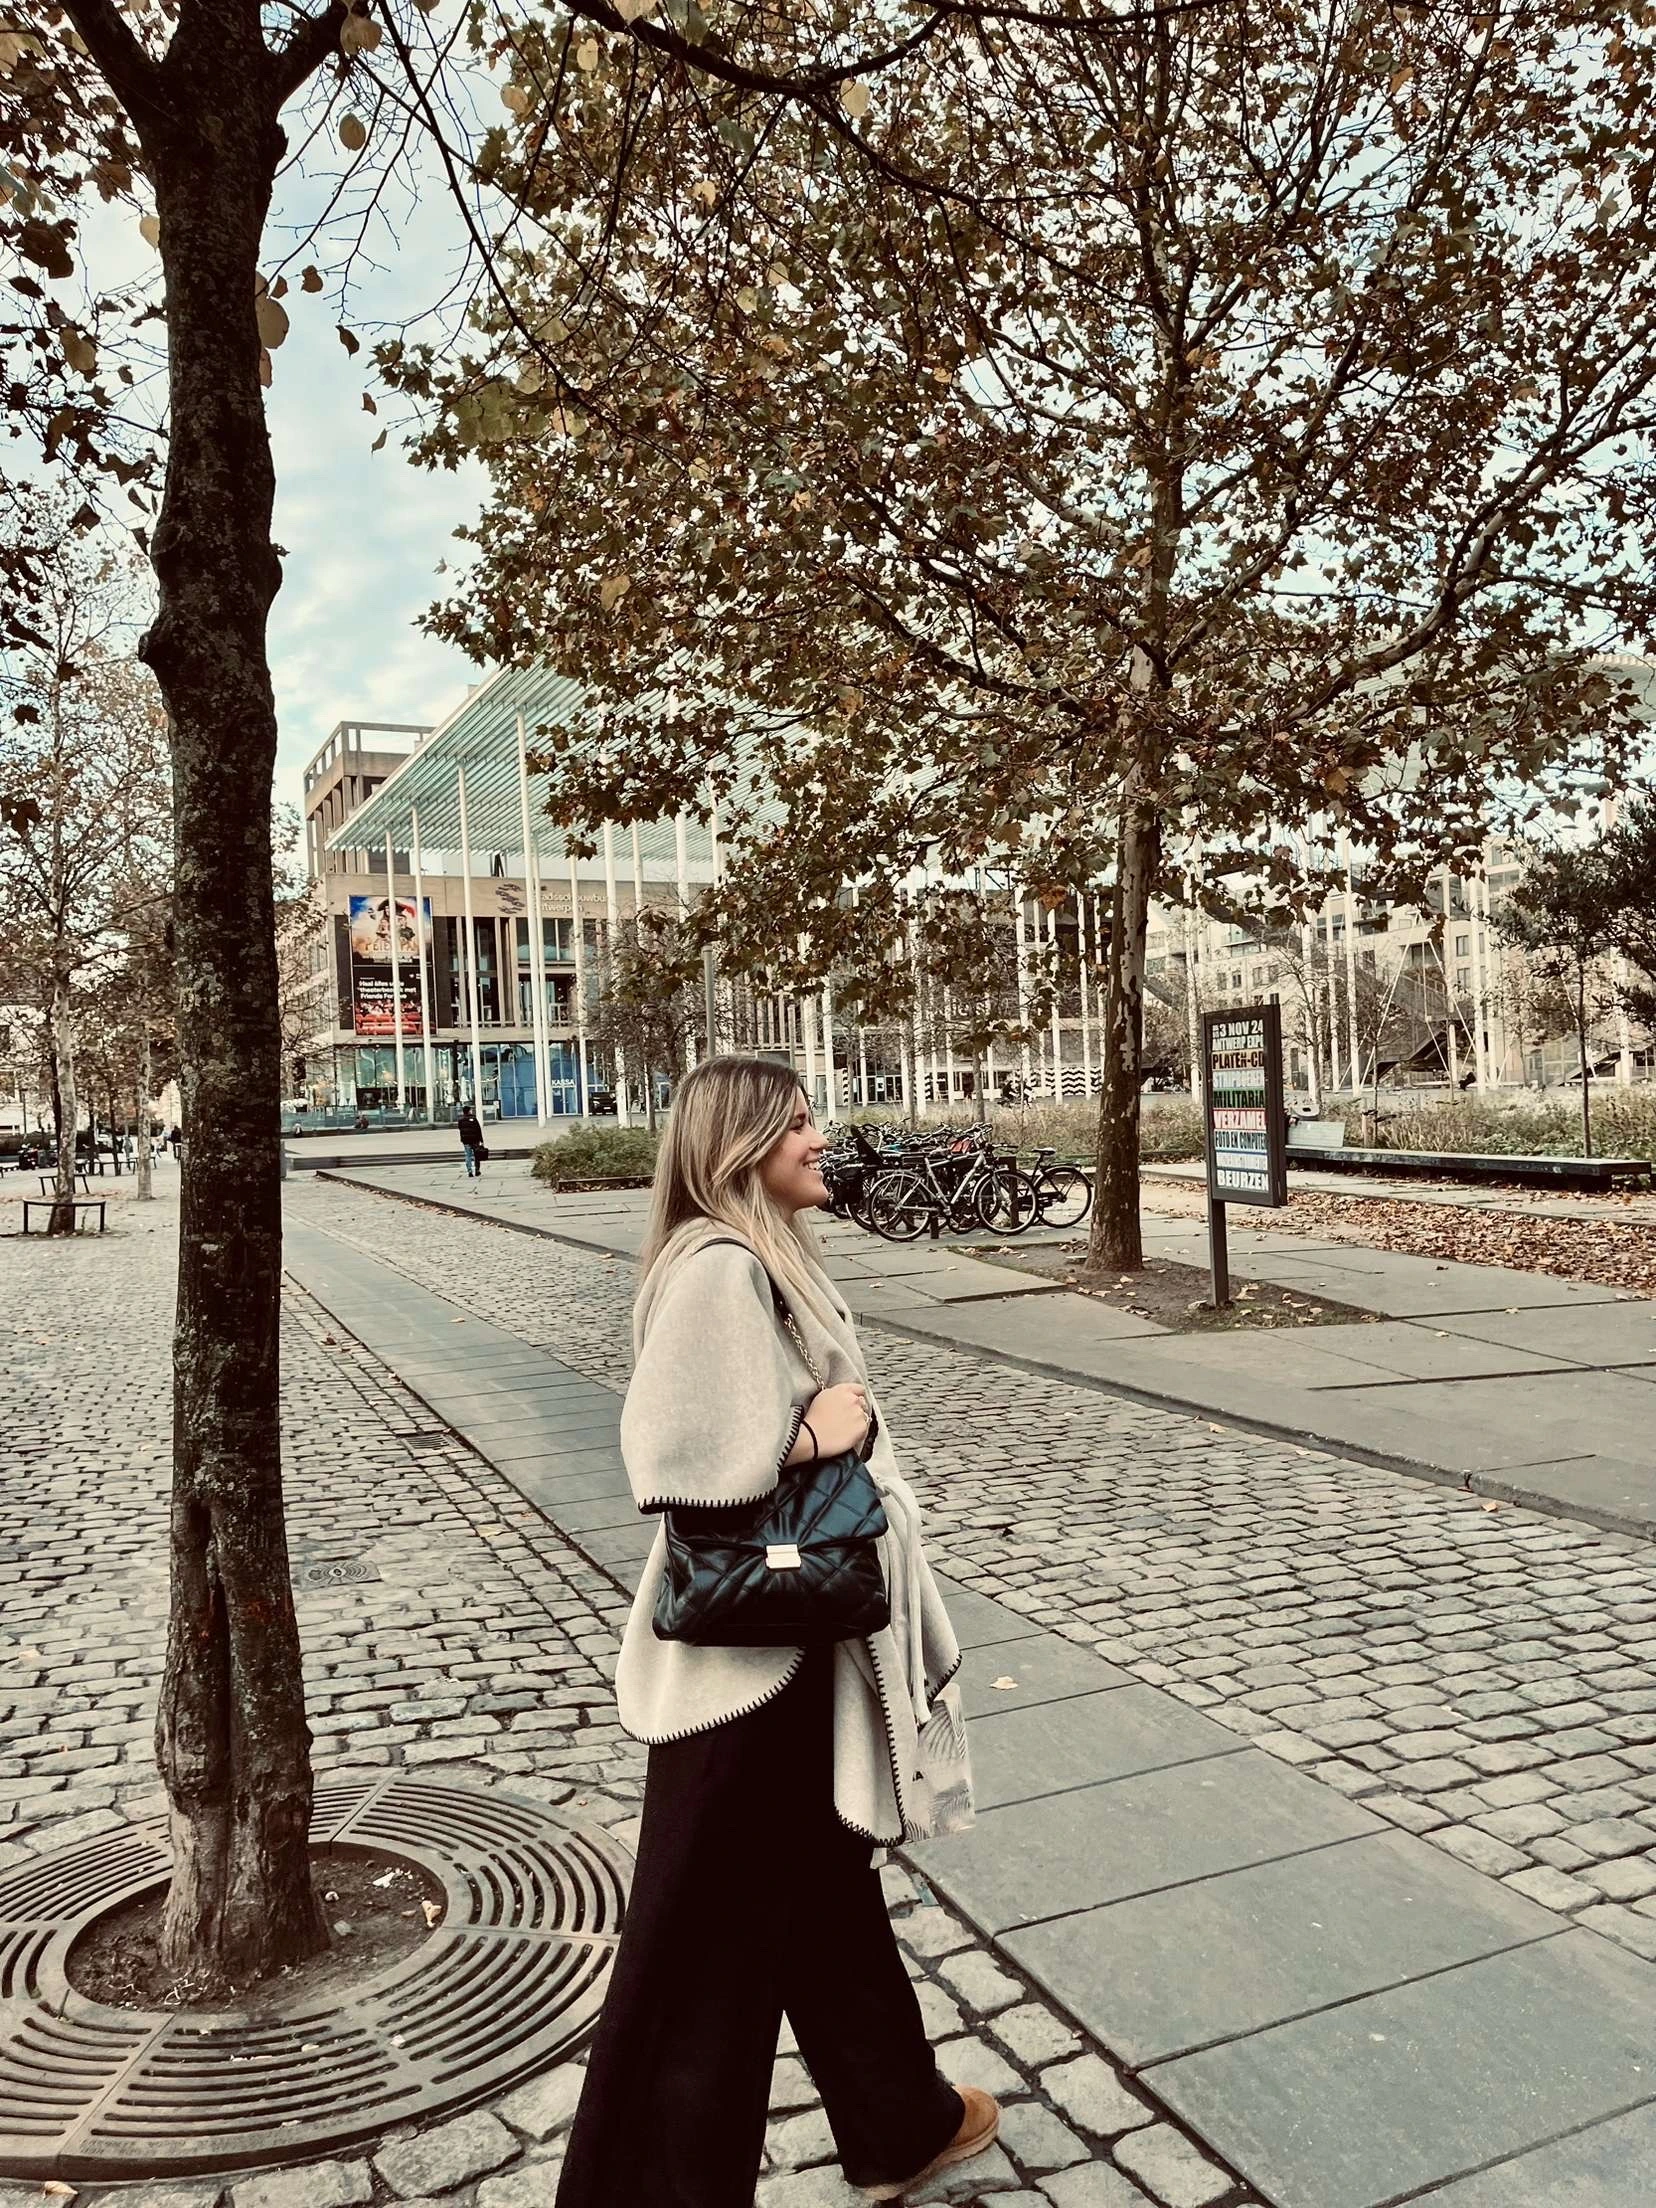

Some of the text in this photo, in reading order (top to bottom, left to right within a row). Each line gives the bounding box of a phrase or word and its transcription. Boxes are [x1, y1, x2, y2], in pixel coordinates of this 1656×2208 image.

[1228, 1021, 1249, 1036] NOV
[1251, 1019, 1263, 1034] 24
[1212, 1036, 1246, 1051] ANTWERP
[1215, 1131, 1229, 1149] FOTO
[1217, 1170, 1268, 1190] BEURZEN
